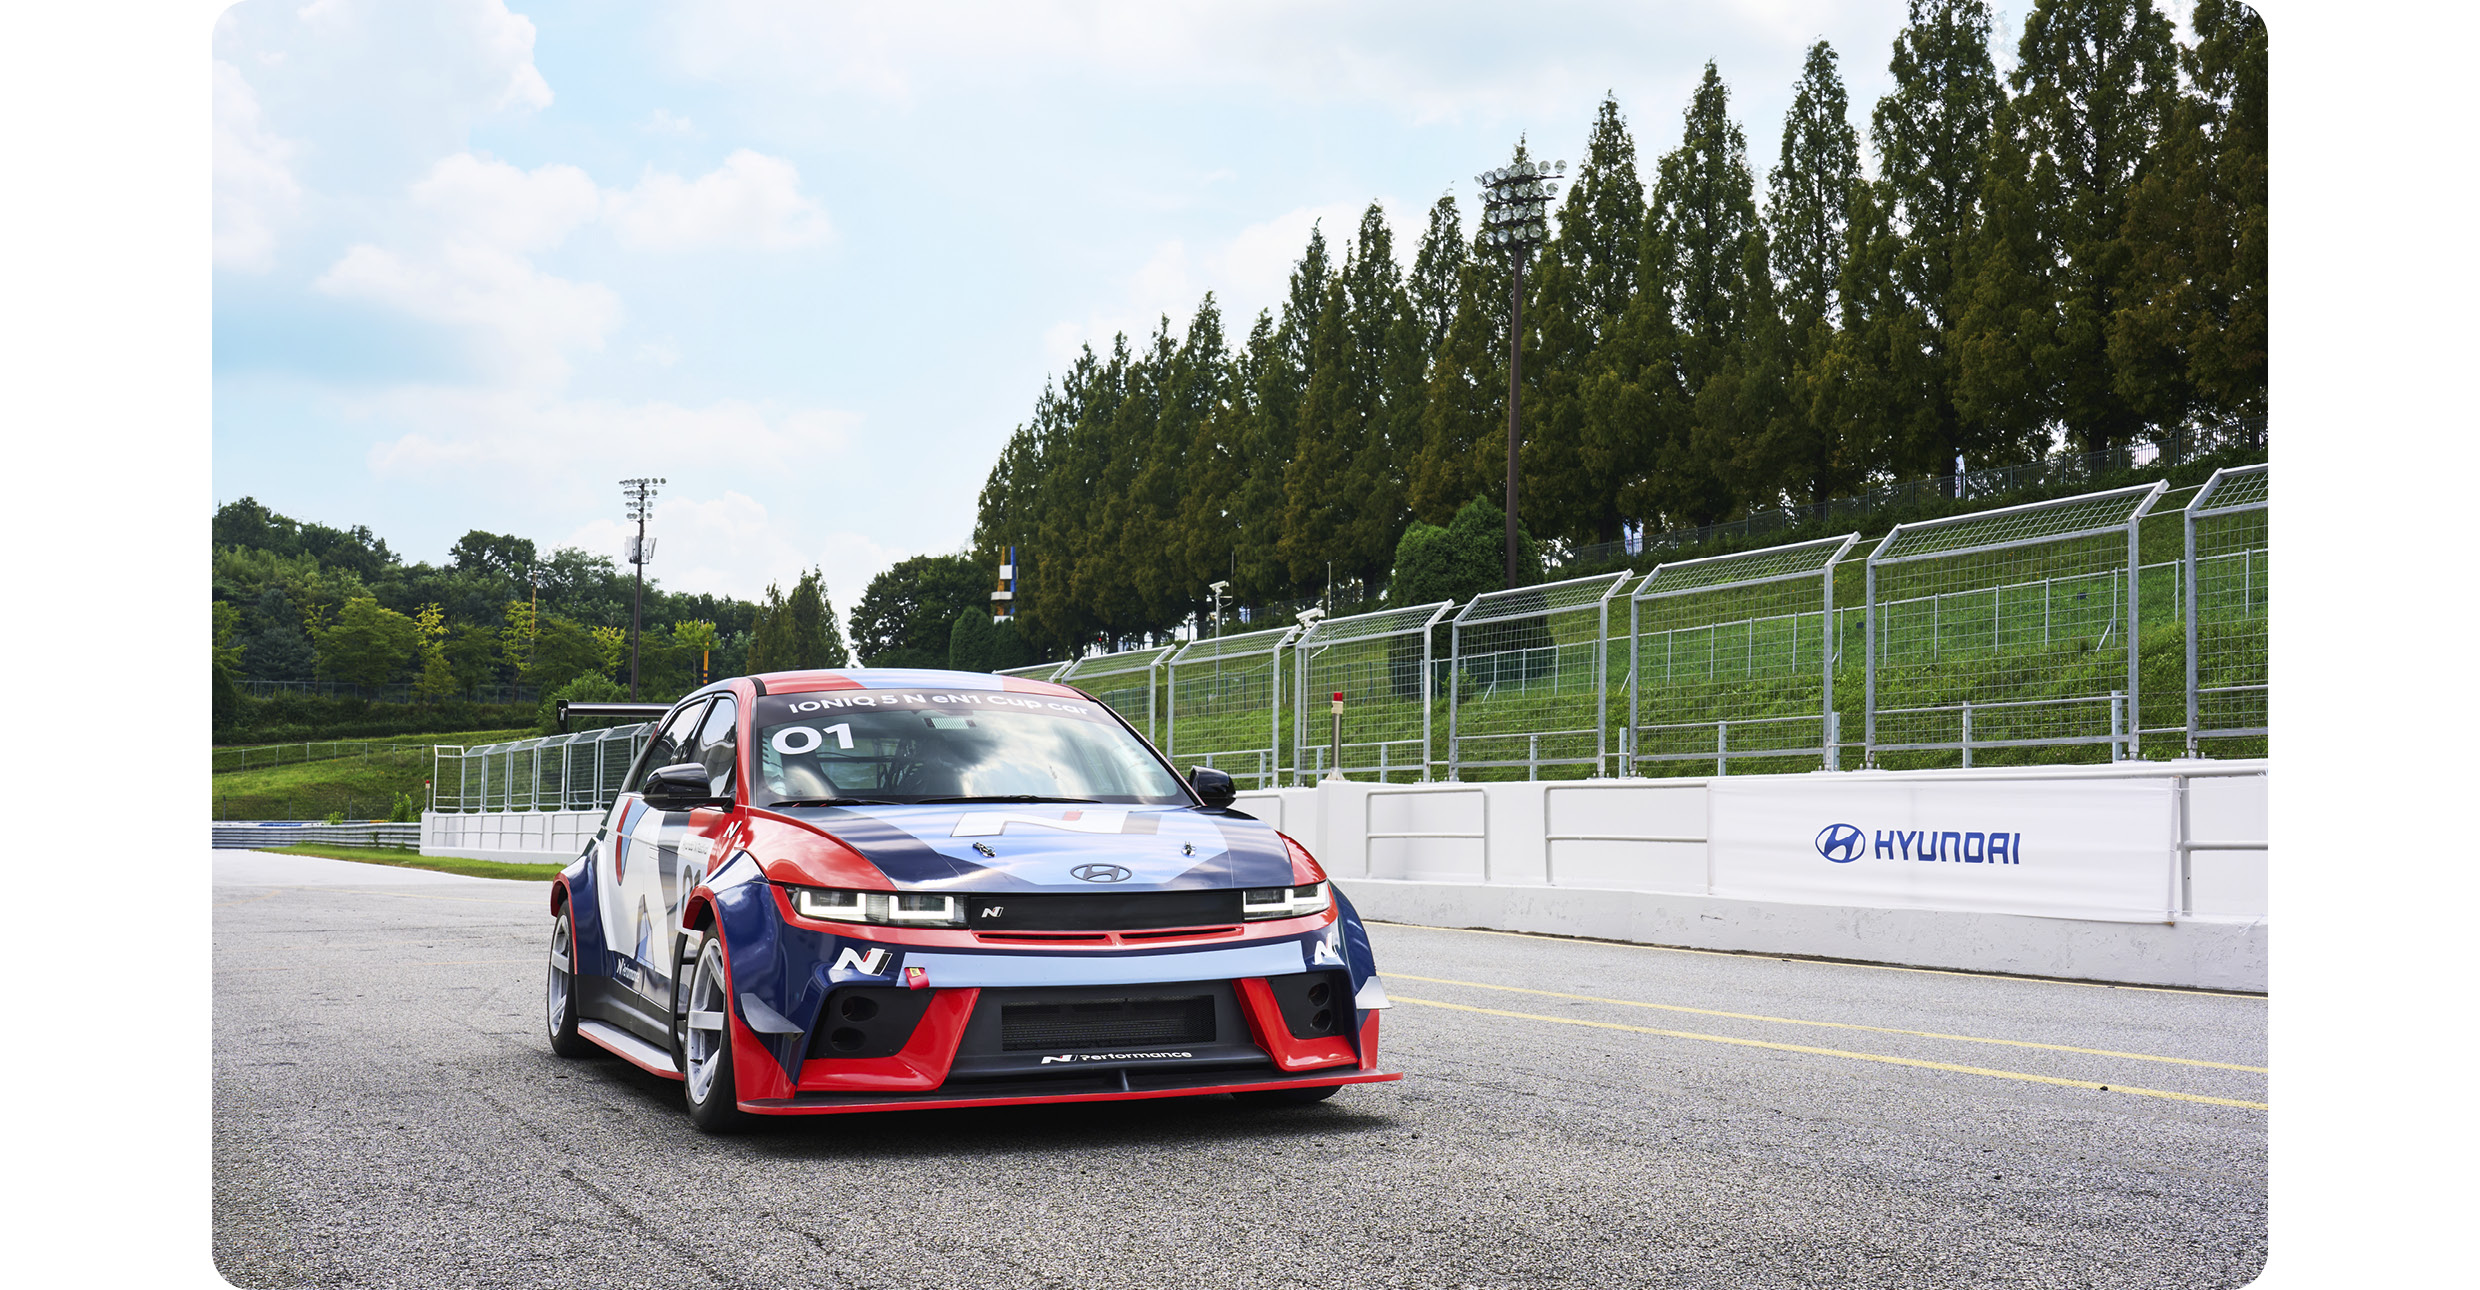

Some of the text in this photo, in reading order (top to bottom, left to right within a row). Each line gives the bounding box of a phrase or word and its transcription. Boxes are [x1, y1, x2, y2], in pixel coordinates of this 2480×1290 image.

[789, 694, 1088, 715] IONIQ 5 N eN1 Cup car
[772, 723, 854, 754] 01
[723, 820, 742, 839] N
[1874, 830, 2020, 864] HYUNDAI
[981, 906, 1004, 918] N
[832, 947, 893, 976] N
[1080, 1052, 1193, 1061] Performance
